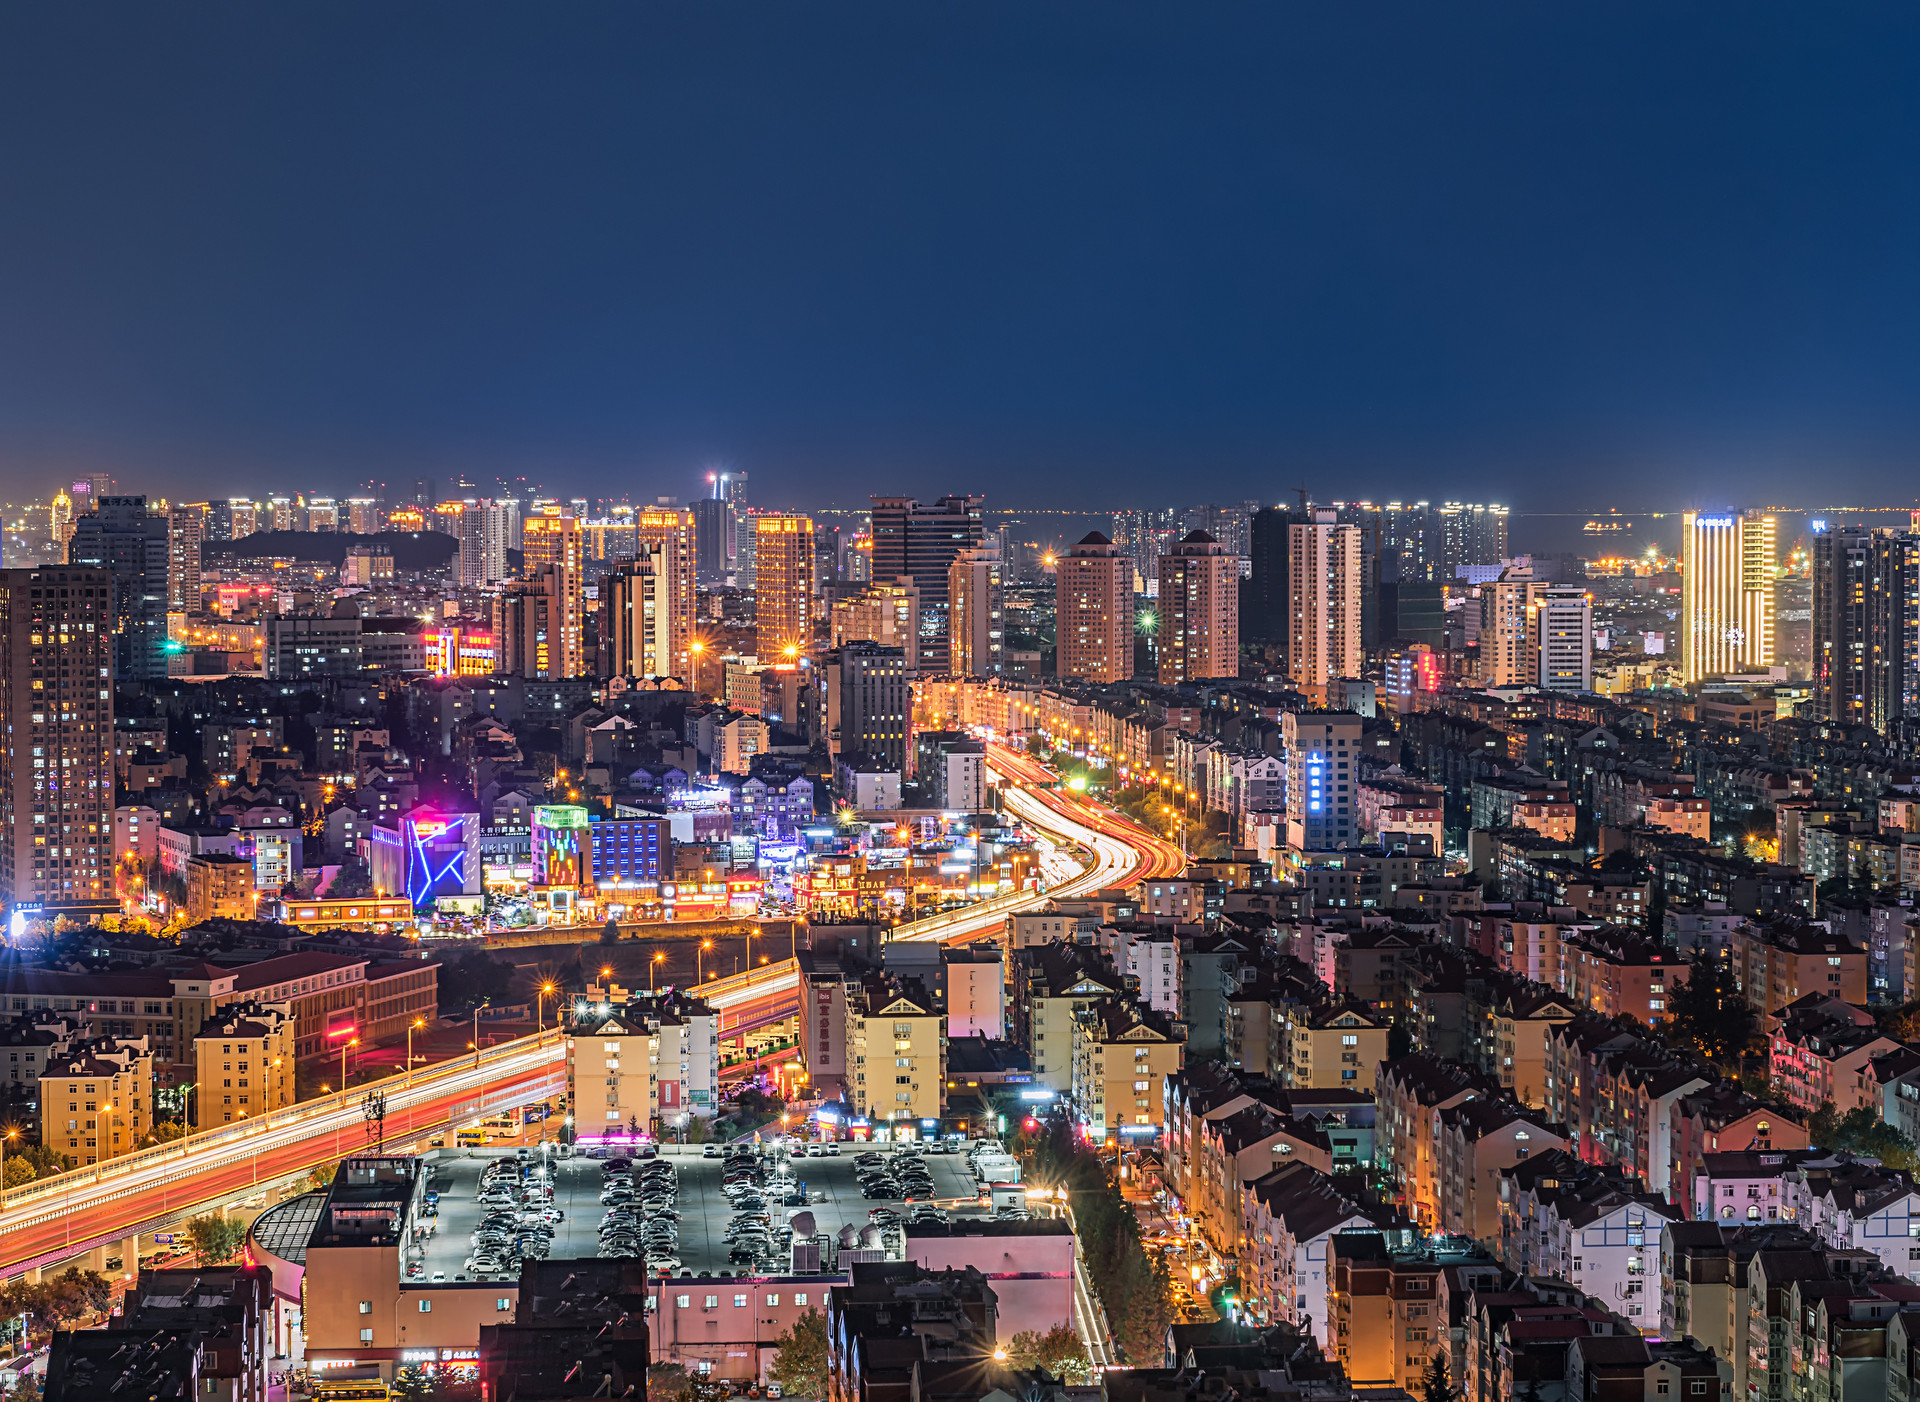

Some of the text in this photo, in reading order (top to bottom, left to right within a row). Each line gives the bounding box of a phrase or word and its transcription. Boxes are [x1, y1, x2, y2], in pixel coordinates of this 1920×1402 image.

[819, 1005, 830, 1065] 宜必思酒店
